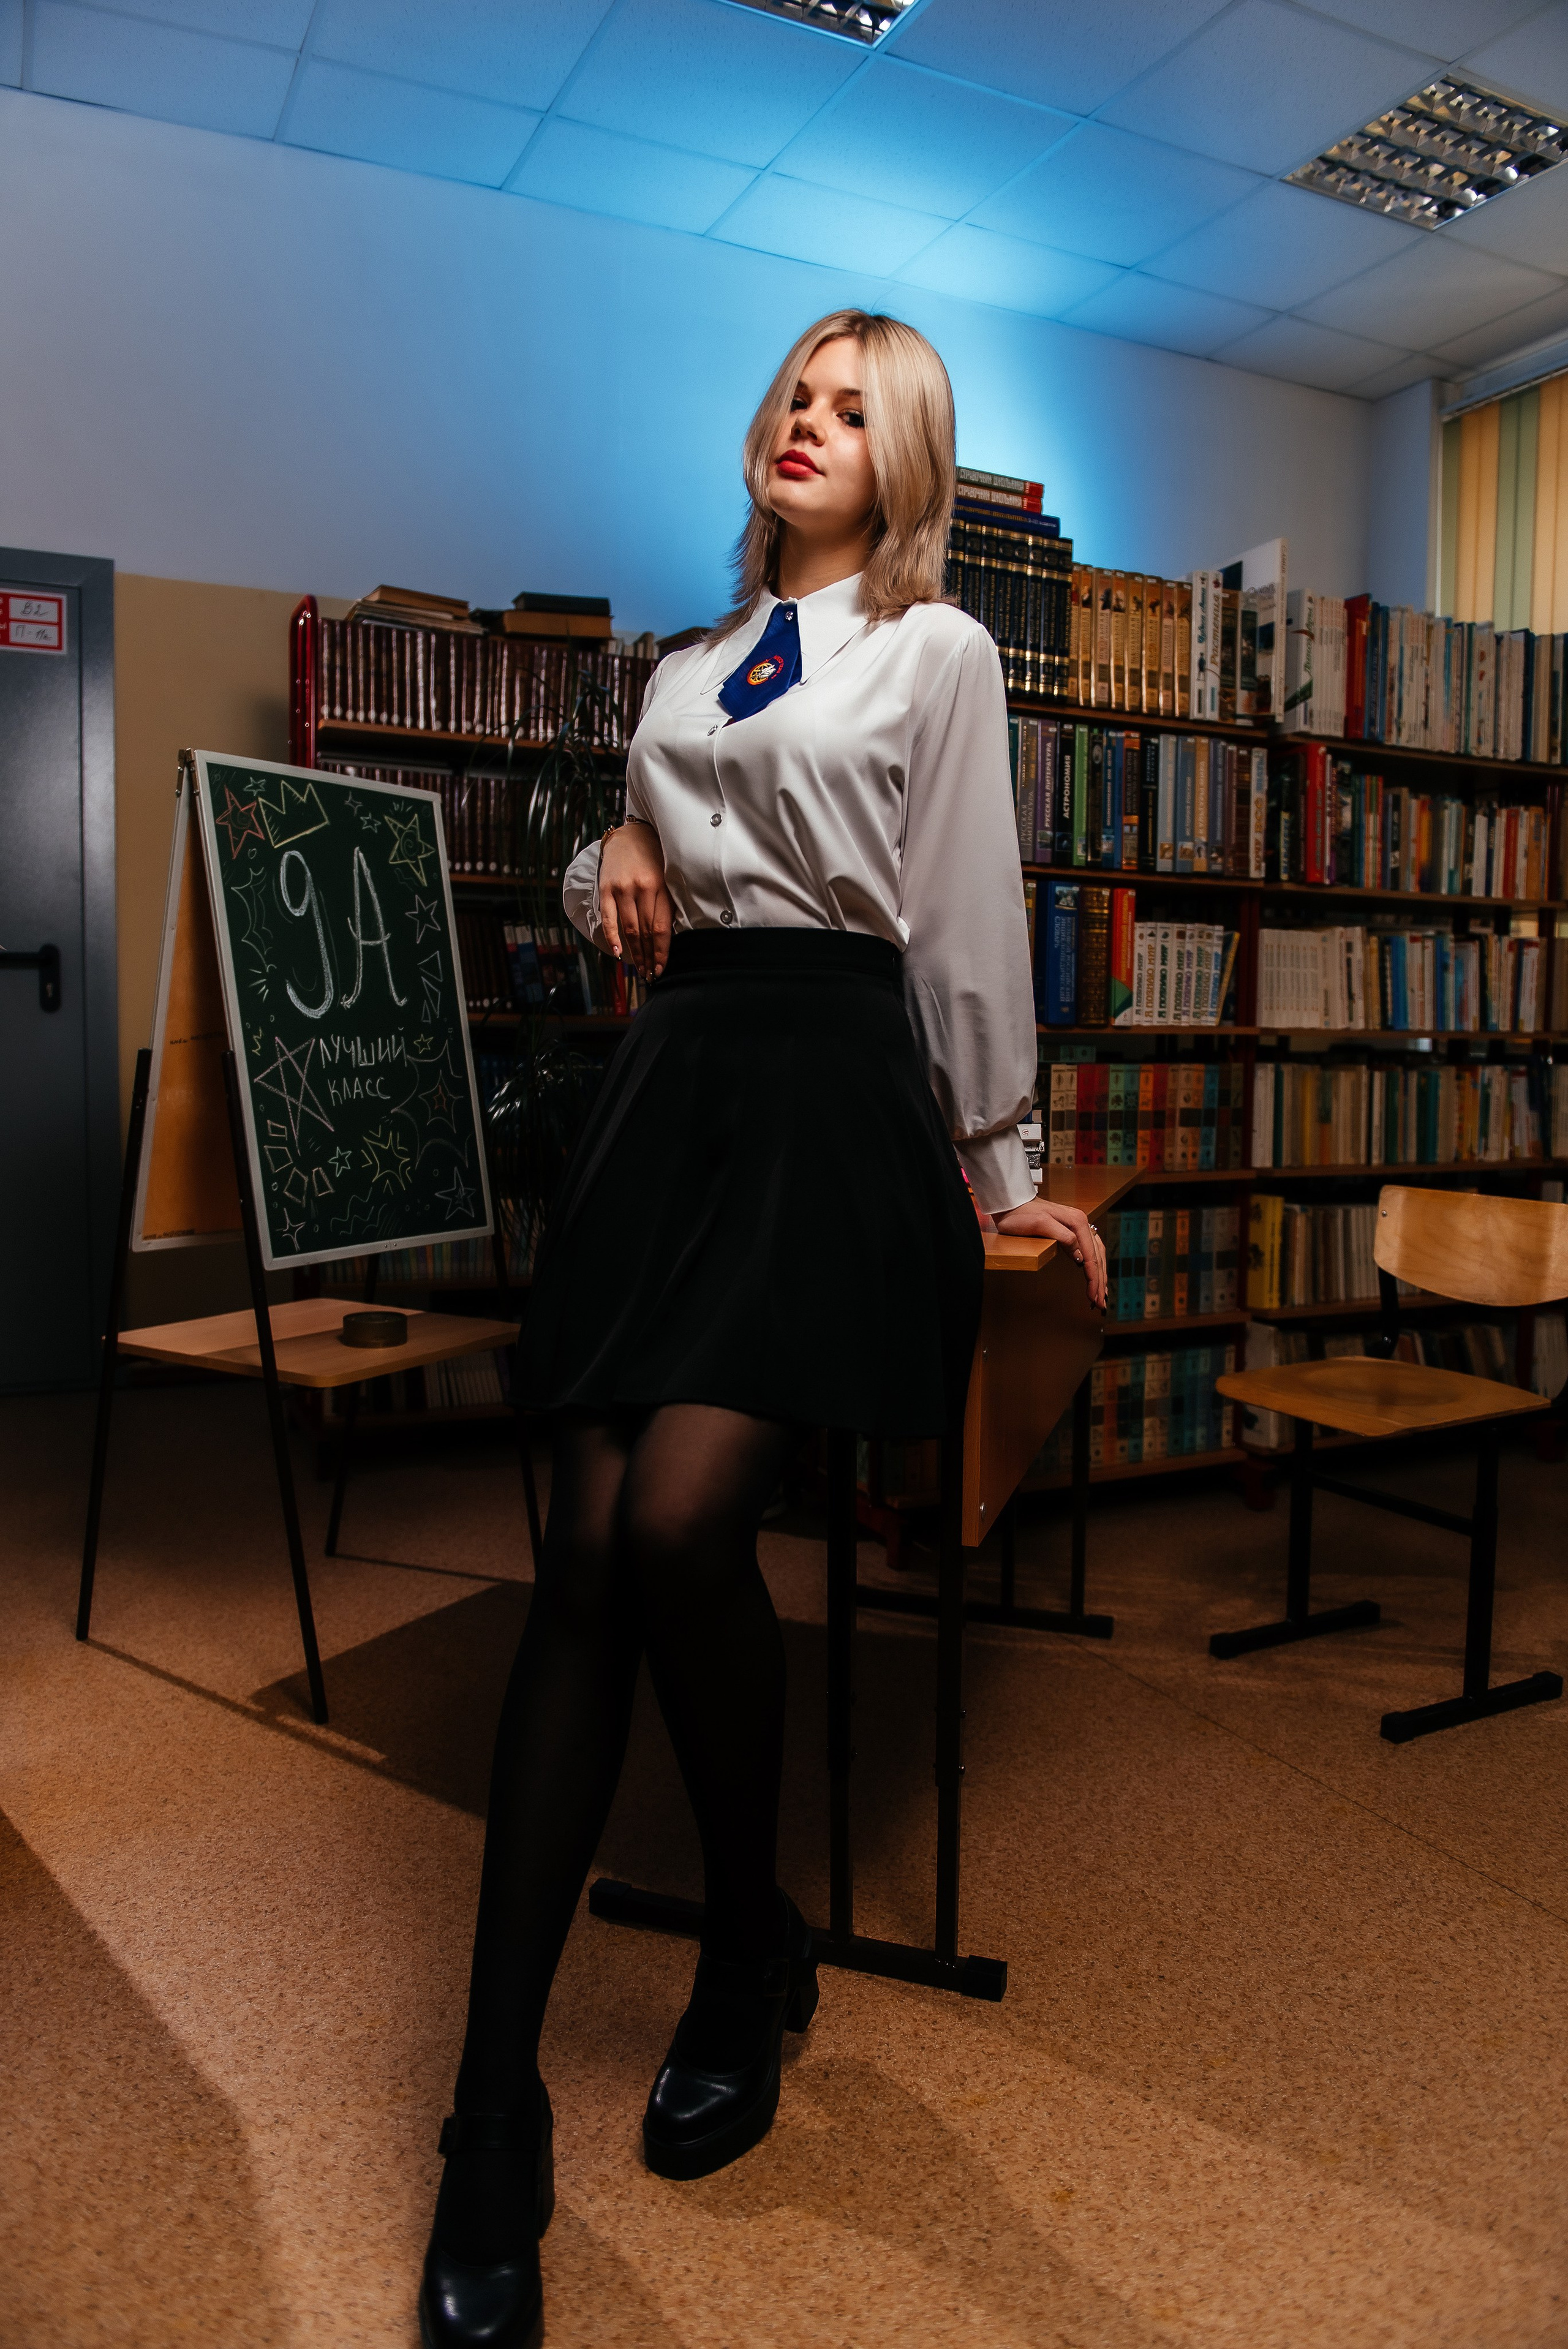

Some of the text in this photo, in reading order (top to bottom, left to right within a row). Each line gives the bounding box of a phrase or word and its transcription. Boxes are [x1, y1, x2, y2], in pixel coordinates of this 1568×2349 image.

[1210, 593, 1220, 666] Растения
[1062, 754, 1072, 820] АСТРОНОМИЯ
[1145, 968, 1154, 1008] ПОЗНАЮ
[1174, 972, 1183, 1011] ПОЗНАЮ
[321, 1027, 409, 1071] ЛУЧШИЙ
[328, 1076, 391, 1107] КЛАСС
